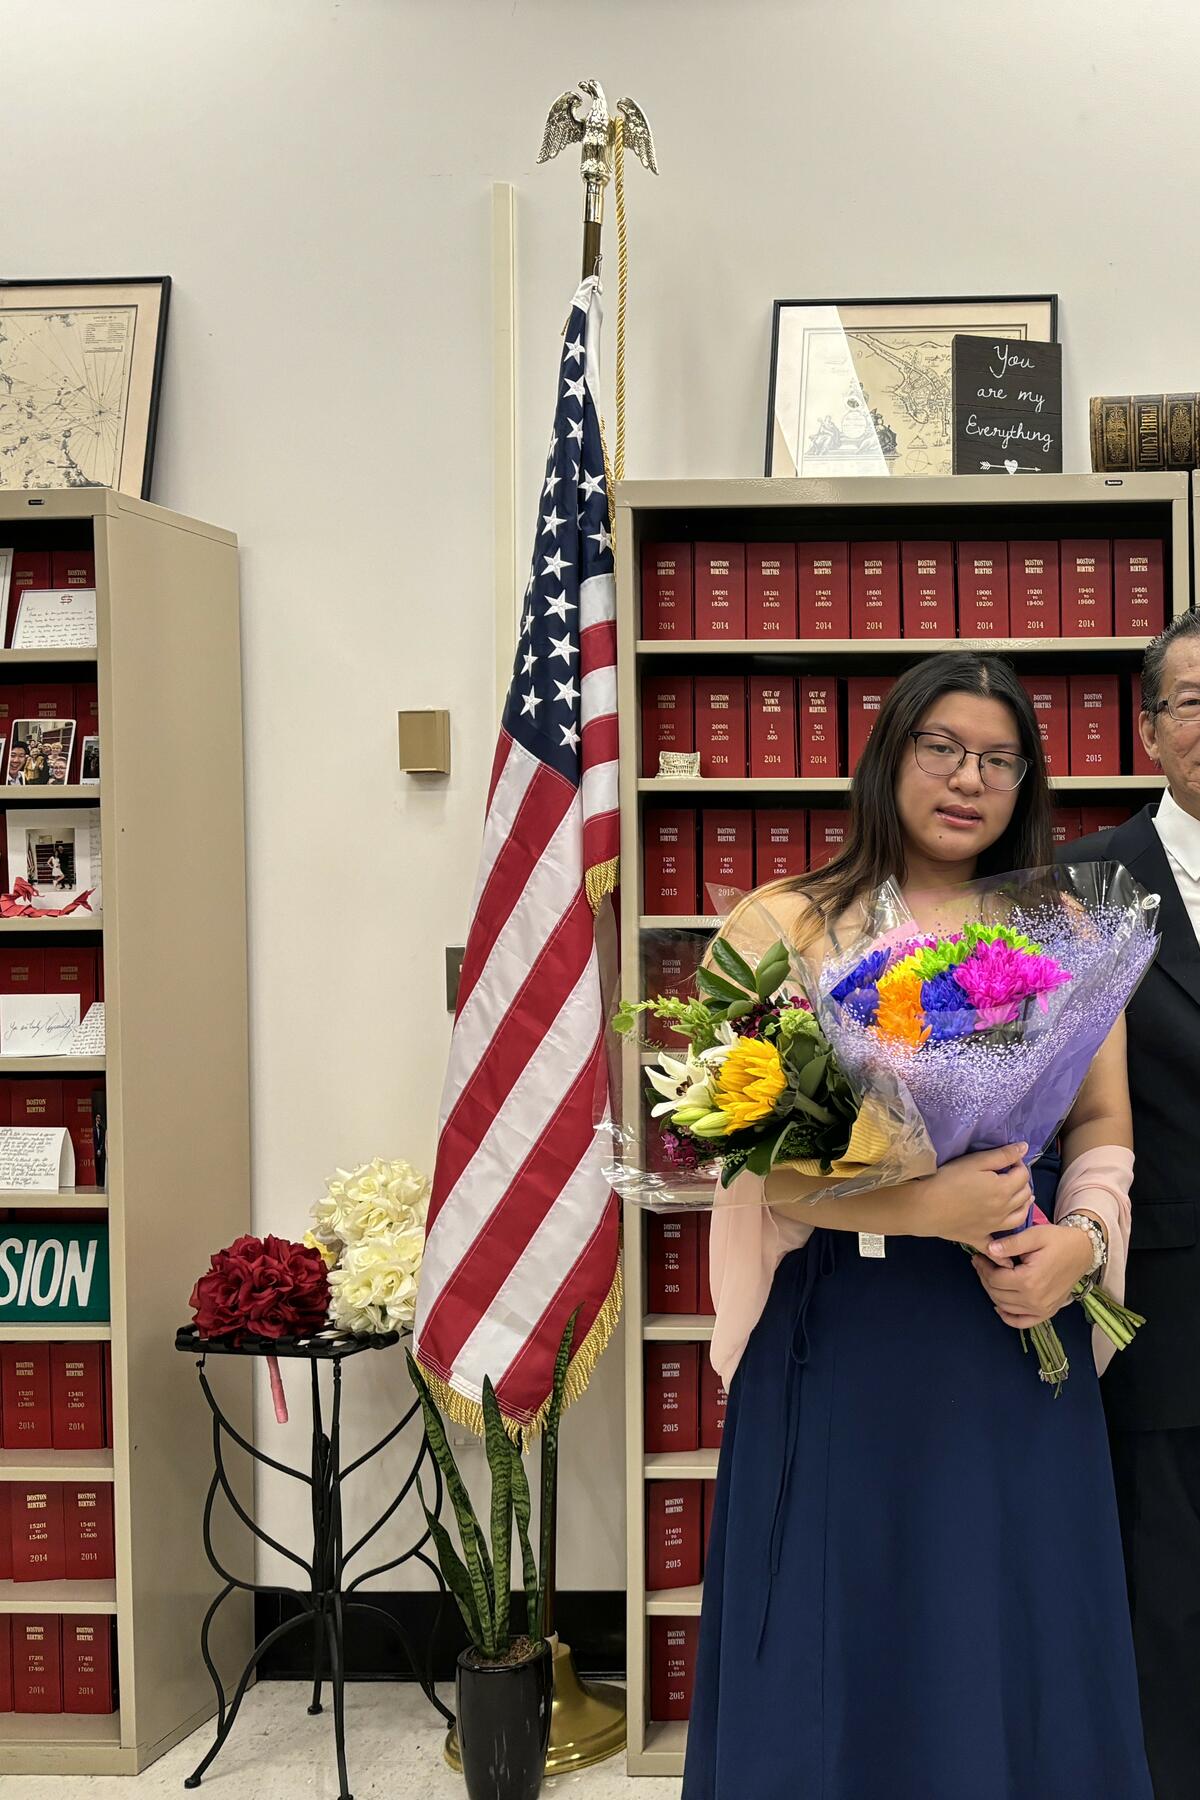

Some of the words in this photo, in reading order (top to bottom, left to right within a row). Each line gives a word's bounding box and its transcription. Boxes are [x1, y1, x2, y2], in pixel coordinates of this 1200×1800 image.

[989, 344, 1035, 378] You
[977, 388, 1007, 399] are
[1018, 390, 1045, 412] my
[1140, 405, 1157, 433] BIBLE
[966, 414, 1054, 452] Everything
[1140, 434, 1158, 462] HOLY
[864, 559, 883, 567] BOSTON
[1024, 558, 1044, 566] BOSTON
[710, 568, 729, 576] BIRTHS
[864, 568, 883, 576] BIRTHS
[711, 621, 729, 630] 2014
[762, 621, 780, 631] 2014
[815, 621, 832, 630] 2014
[866, 621, 883, 630] 2014
[976, 621, 994, 630] 2014
[1027, 620, 1044, 629] 2014
[1078, 619, 1095, 628] 2014
[808, 706, 828, 714] BIRTHS
[711, 755, 729, 764] 2014
[763, 754, 781, 764] 2014
[810, 755, 827, 764] 2014
[660, 887, 678, 896] 2015
[0, 1237, 98, 1307] SION
[662, 1370, 680, 1378] BIRTHS
[662, 1423, 679, 1433] 2015
[26, 1493, 47, 1501] BOSTON
[29, 1553, 48, 1563] 2014
